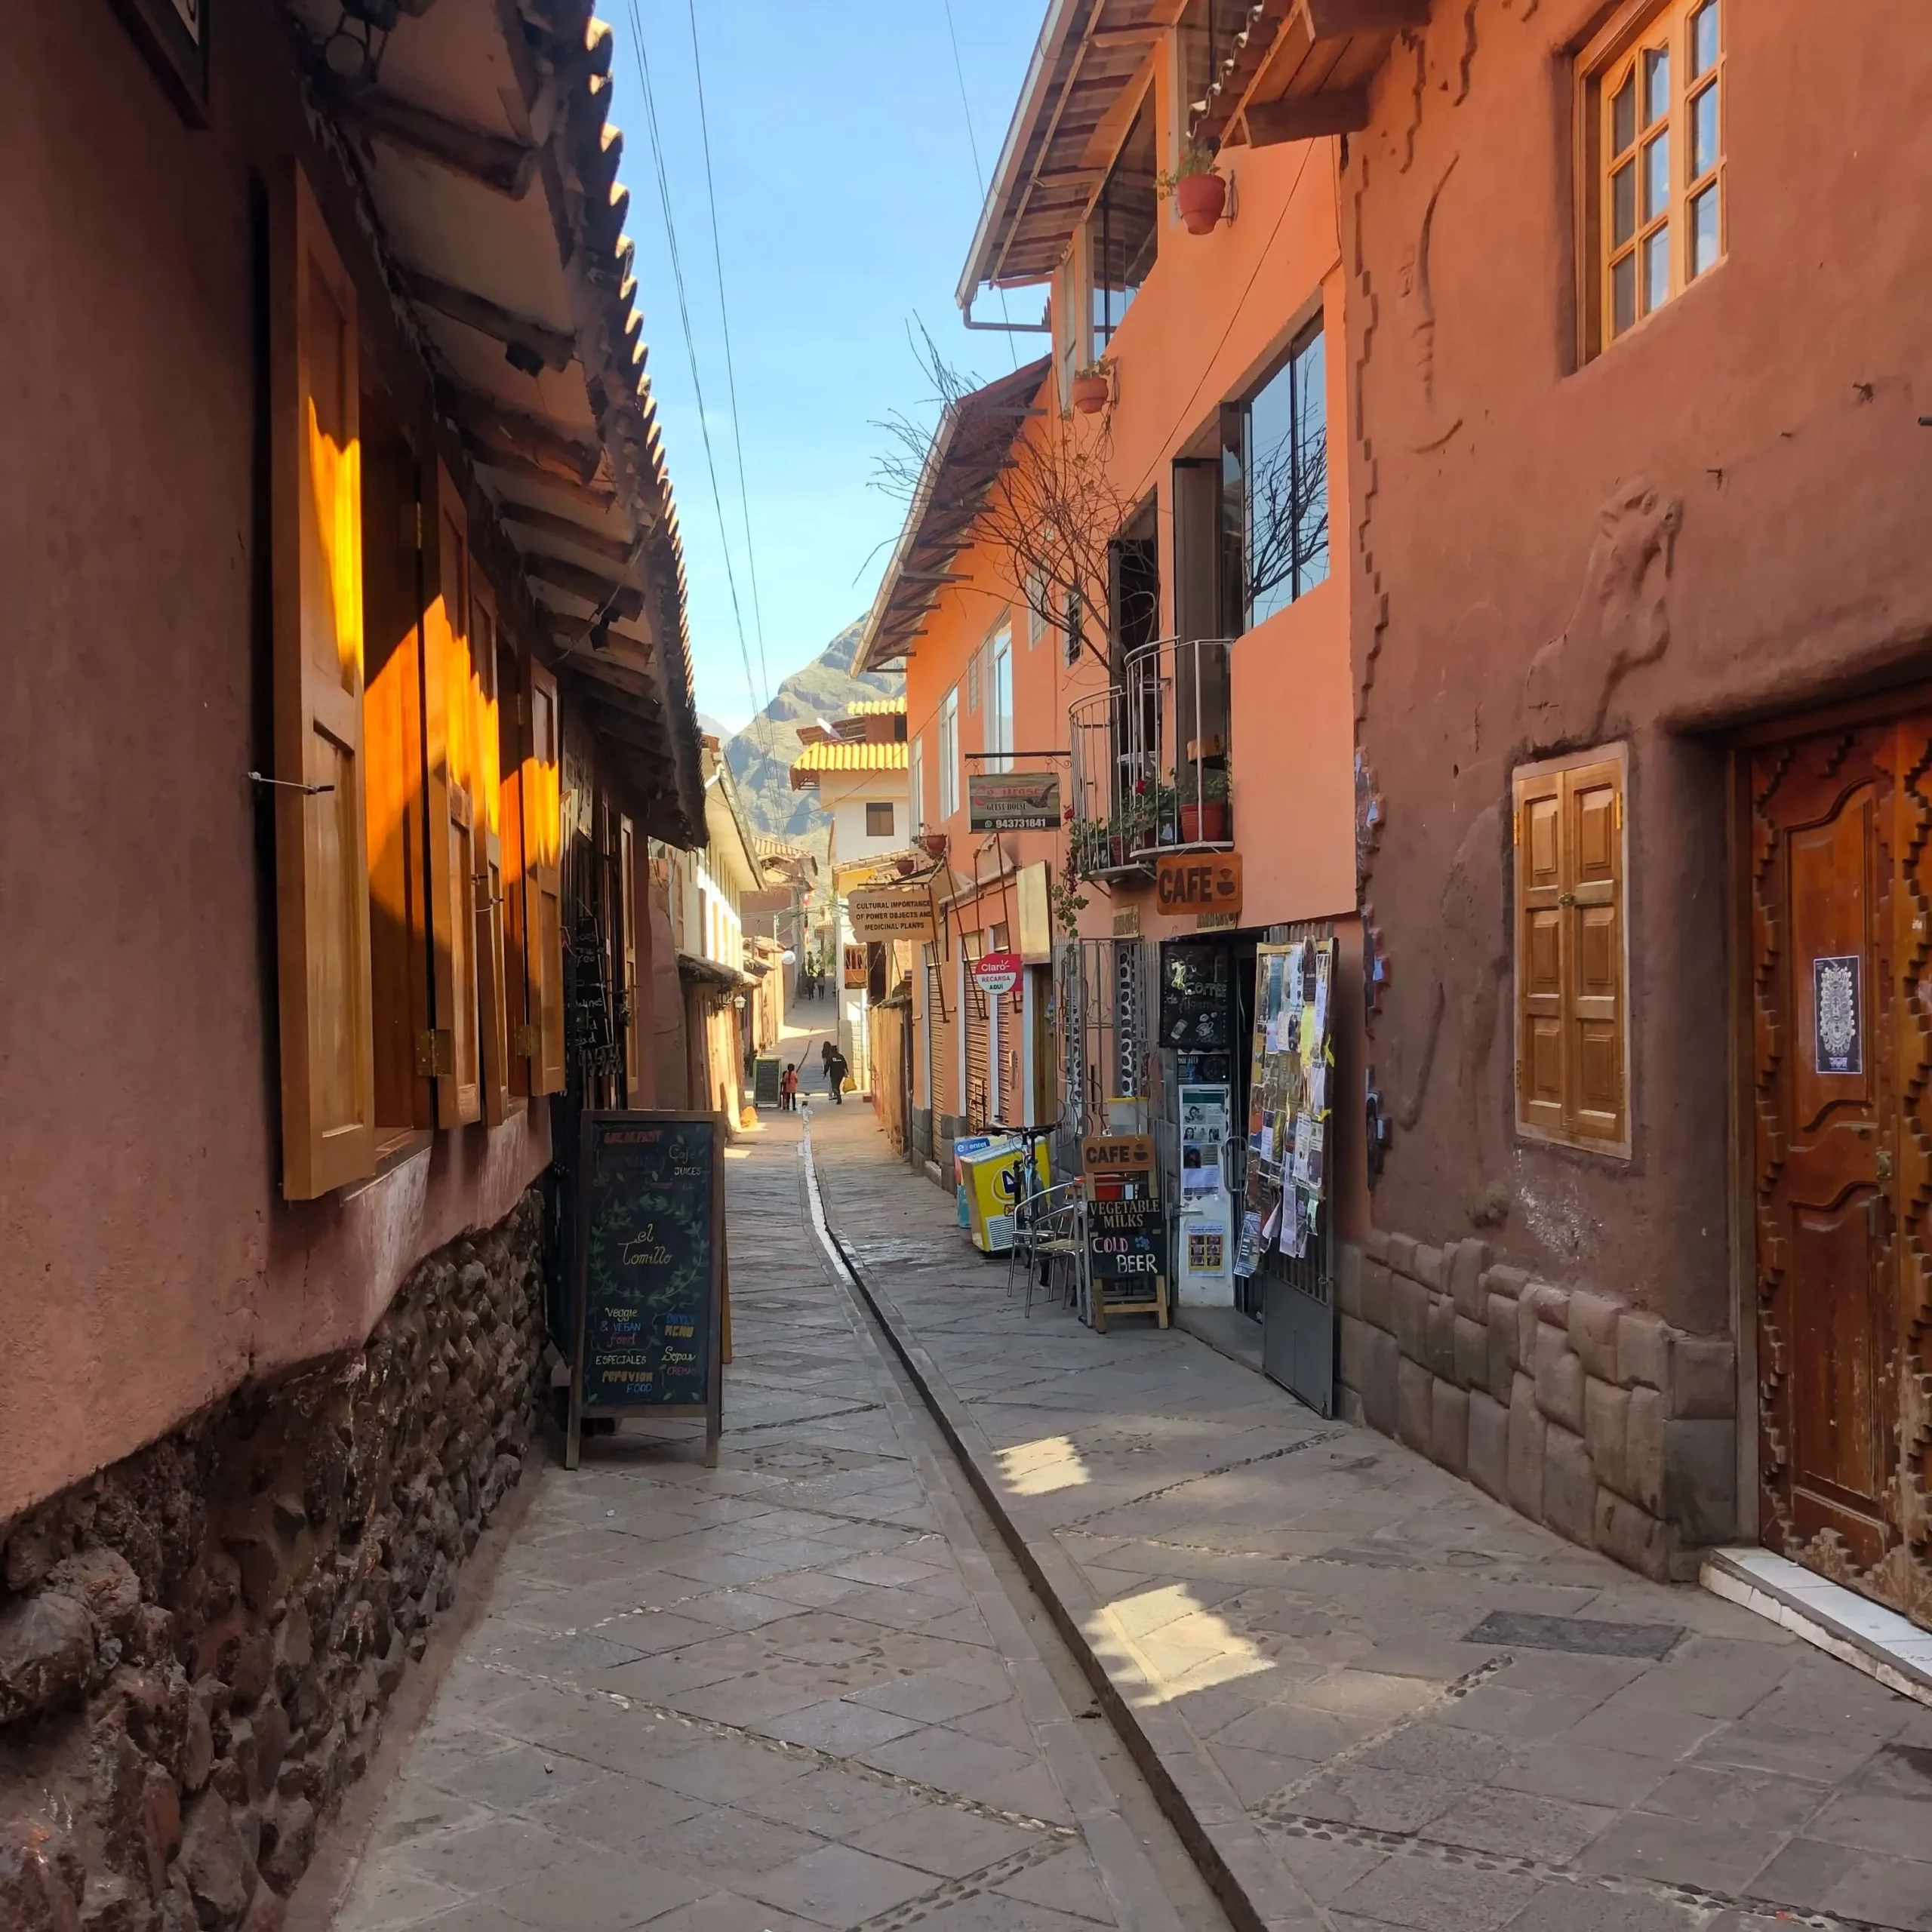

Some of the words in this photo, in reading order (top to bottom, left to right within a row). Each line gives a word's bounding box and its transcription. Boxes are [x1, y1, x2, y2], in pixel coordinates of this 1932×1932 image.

[1007, 802, 1026, 811] HOUSE
[1159, 866, 1212, 903] CAFE
[891, 900, 931, 908] IMPORTANCE
[981, 963, 1007, 971] Claro
[1086, 1145, 1130, 1163] CAFE
[674, 1166, 701, 1176] JUICES
[1089, 1199, 1160, 1216] VEGETABLE
[1103, 1214, 1144, 1229] MILKS
[1092, 1236, 1128, 1254] COLD
[617, 1243, 672, 1266] Tomillo
[1116, 1254, 1158, 1274] BEER
[600, 1321, 609, 1332] &
[613, 1322, 641, 1332] VEGAN
[607, 1333, 637, 1348] food
[595, 1355, 647, 1365] ESPECIALES
[661, 1346, 697, 1364] Sopas
[667, 1367, 696, 1376] CREMAS
[626, 1383, 653, 1394] FOOD
